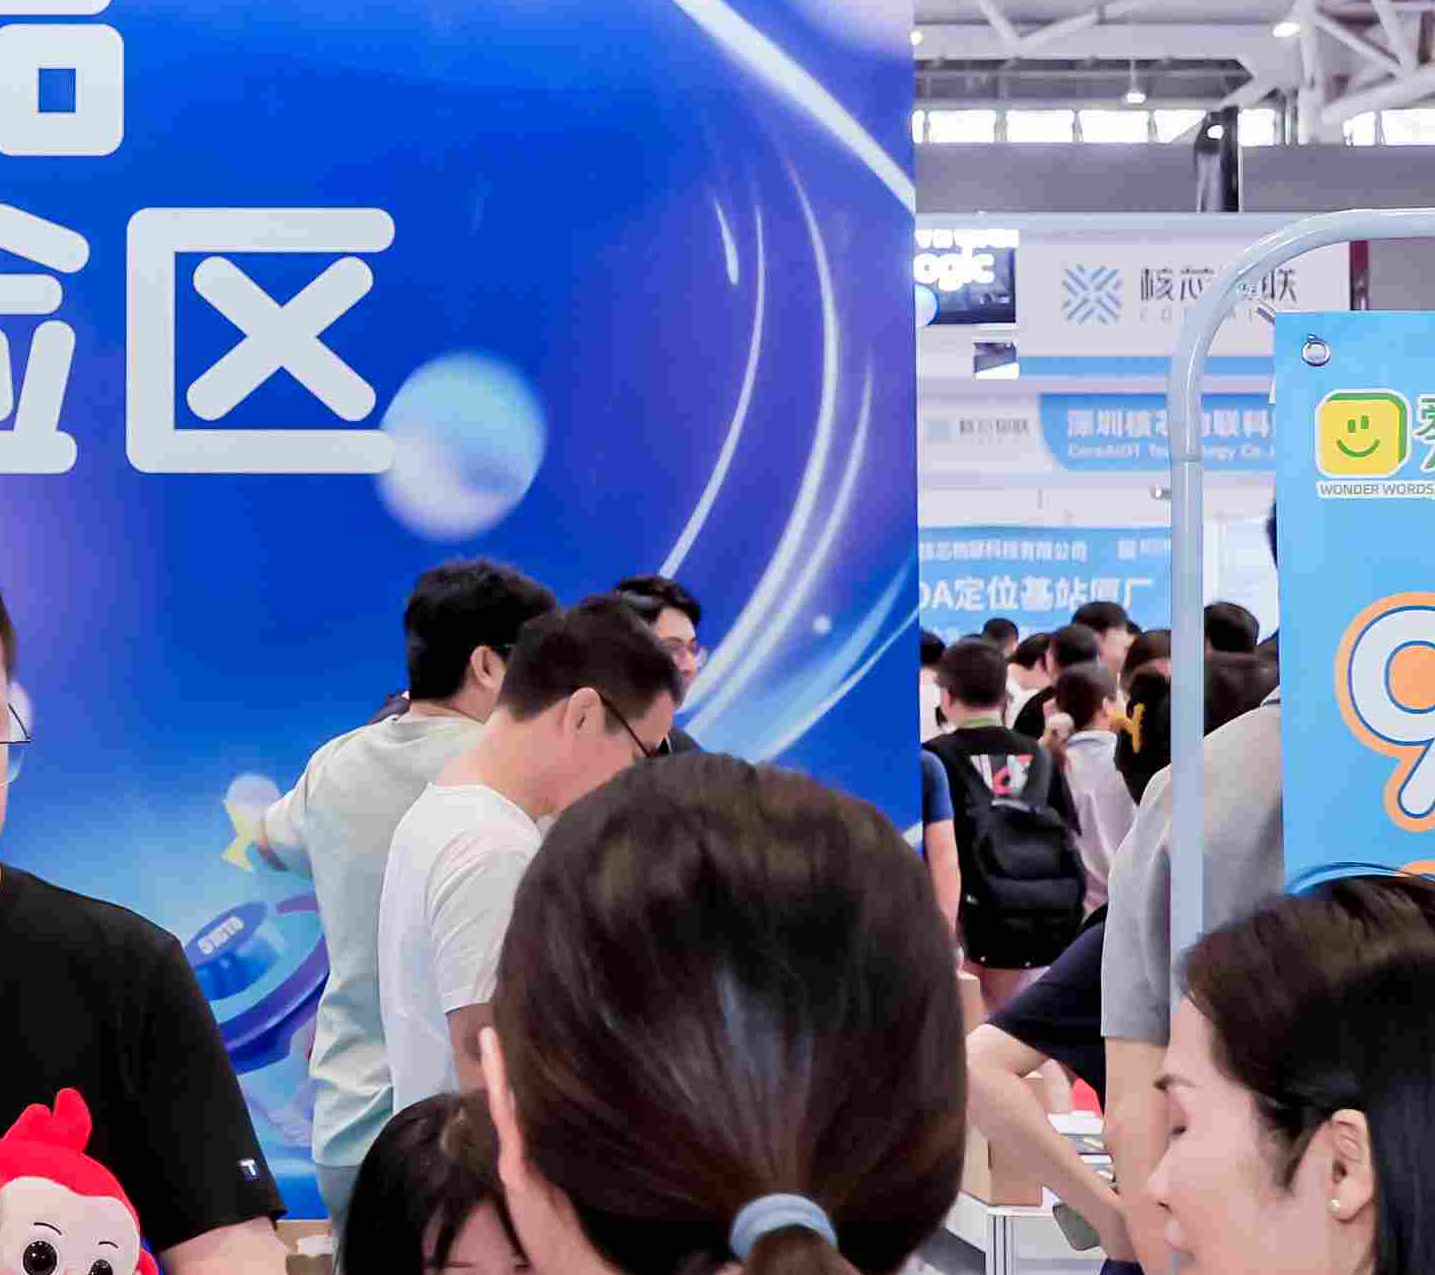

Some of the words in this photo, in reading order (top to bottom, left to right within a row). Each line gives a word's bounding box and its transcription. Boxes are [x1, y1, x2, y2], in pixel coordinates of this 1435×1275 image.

[1140, 268, 1297, 302] 核芯联
[1320, 483, 1379, 495] WONDER
